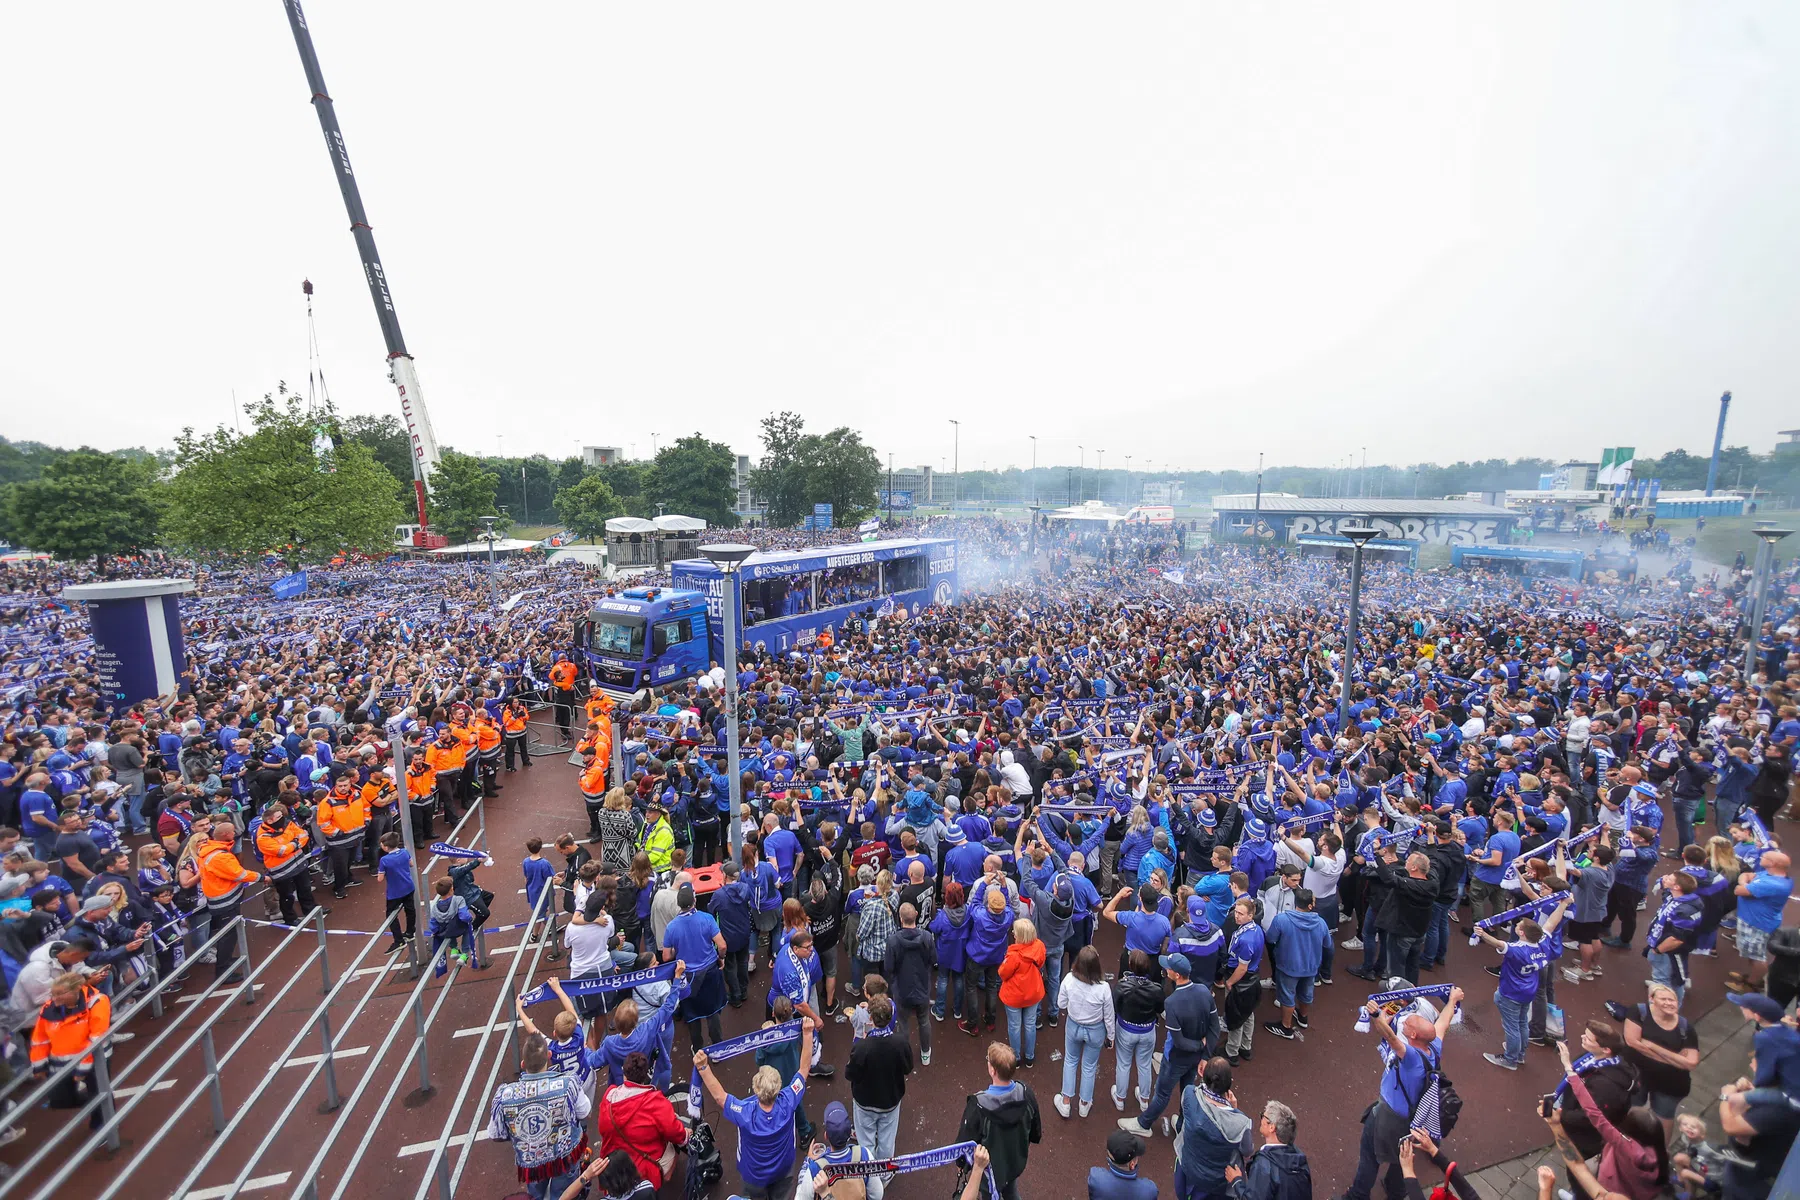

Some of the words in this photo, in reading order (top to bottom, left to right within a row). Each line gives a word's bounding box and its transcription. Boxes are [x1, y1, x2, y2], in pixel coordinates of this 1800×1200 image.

[333, 130, 352, 176] BULLER
[373, 262, 393, 311] BULLER
[399, 385, 424, 461] BULLER
[762, 567, 771, 575] FC
[771, 564, 792, 574] Schalke
[792, 563, 800, 571] 04
[827, 553, 861, 568] AUFSTEIGER
[861, 552, 875, 563] 2022
[627, 604, 641, 613] 2022
[870, 855, 880, 875] 3
[579, 968, 656, 989] Mitglied
